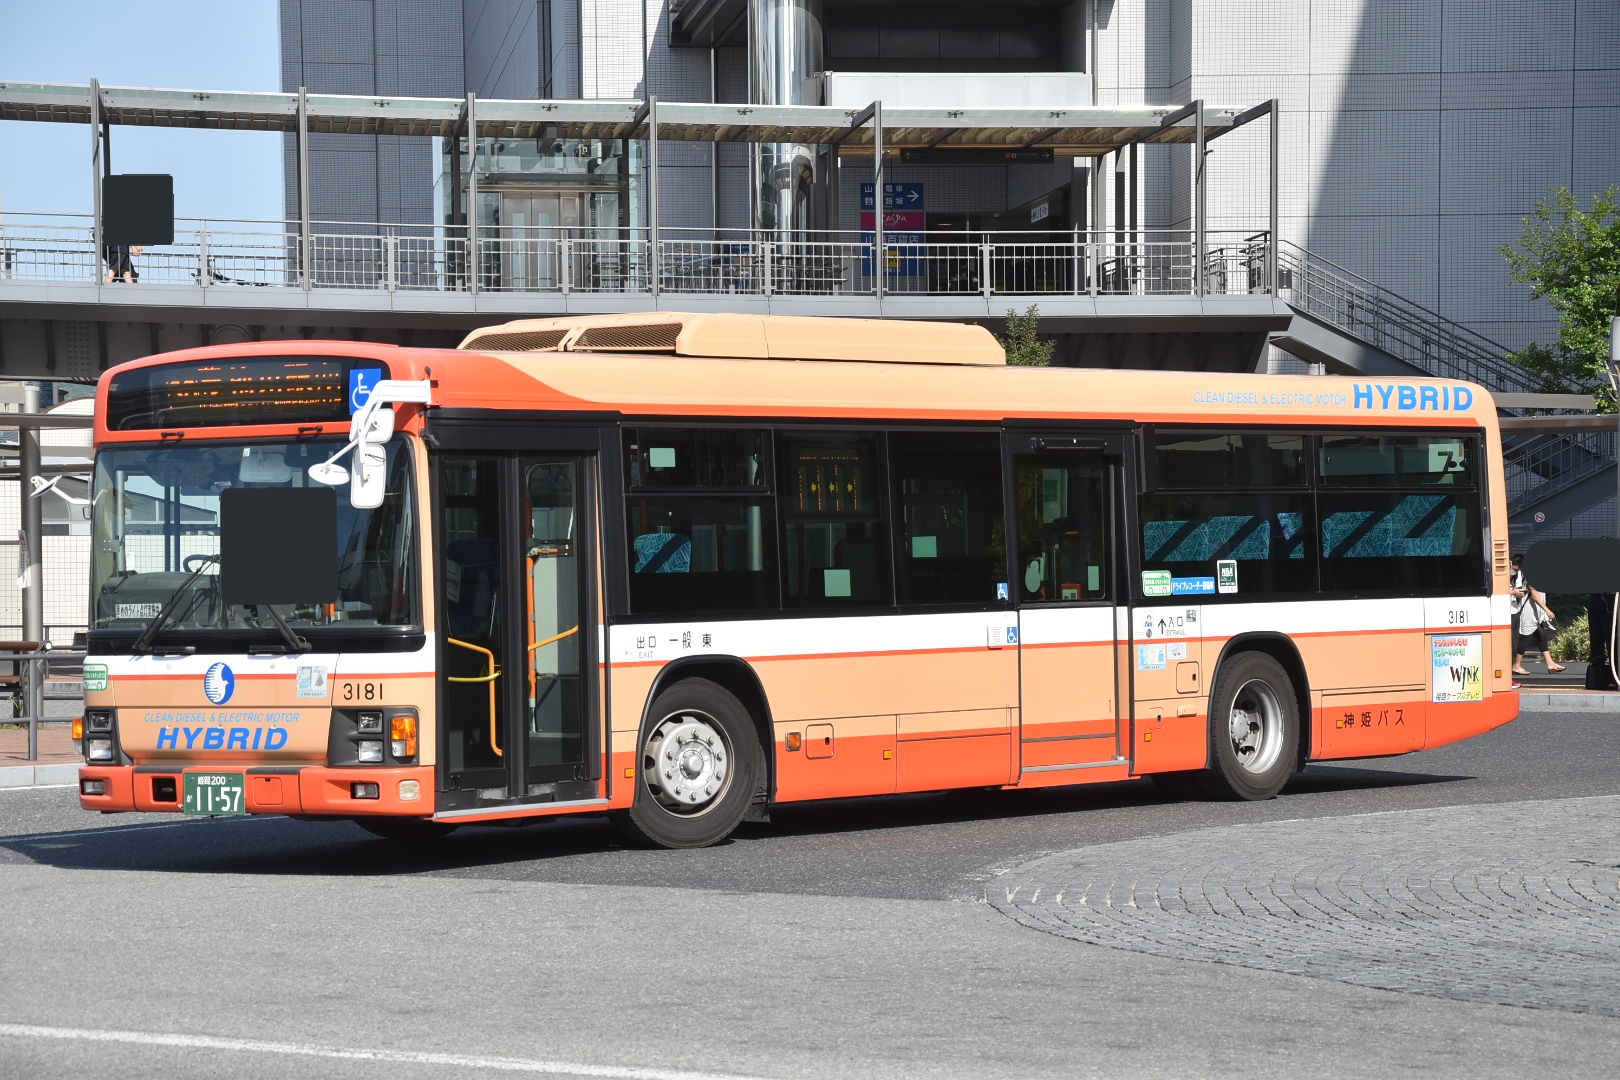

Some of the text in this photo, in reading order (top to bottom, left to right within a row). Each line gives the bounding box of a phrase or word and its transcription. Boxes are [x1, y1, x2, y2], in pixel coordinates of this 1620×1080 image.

[1194, 391, 1347, 405] CLEAN DIESEL & ELECTRIC MOTOR
[1353, 384, 1473, 411] HYBRID
[1168, 616, 1184, 627] 入口
[1448, 610, 1469, 624] 3181
[636, 635, 657, 649] 出口
[669, 630, 692, 649] 一般
[638, 650, 654, 659] EXIT
[343, 682, 383, 700] 3181
[144, 712, 300, 723] CLEAN DIESEL & ELECTRIC MOTOR
[1343, 709, 1405, 728] 神姫バス
[156, 727, 288, 750] HYBRID
[196, 786, 242, 812] 11-57
